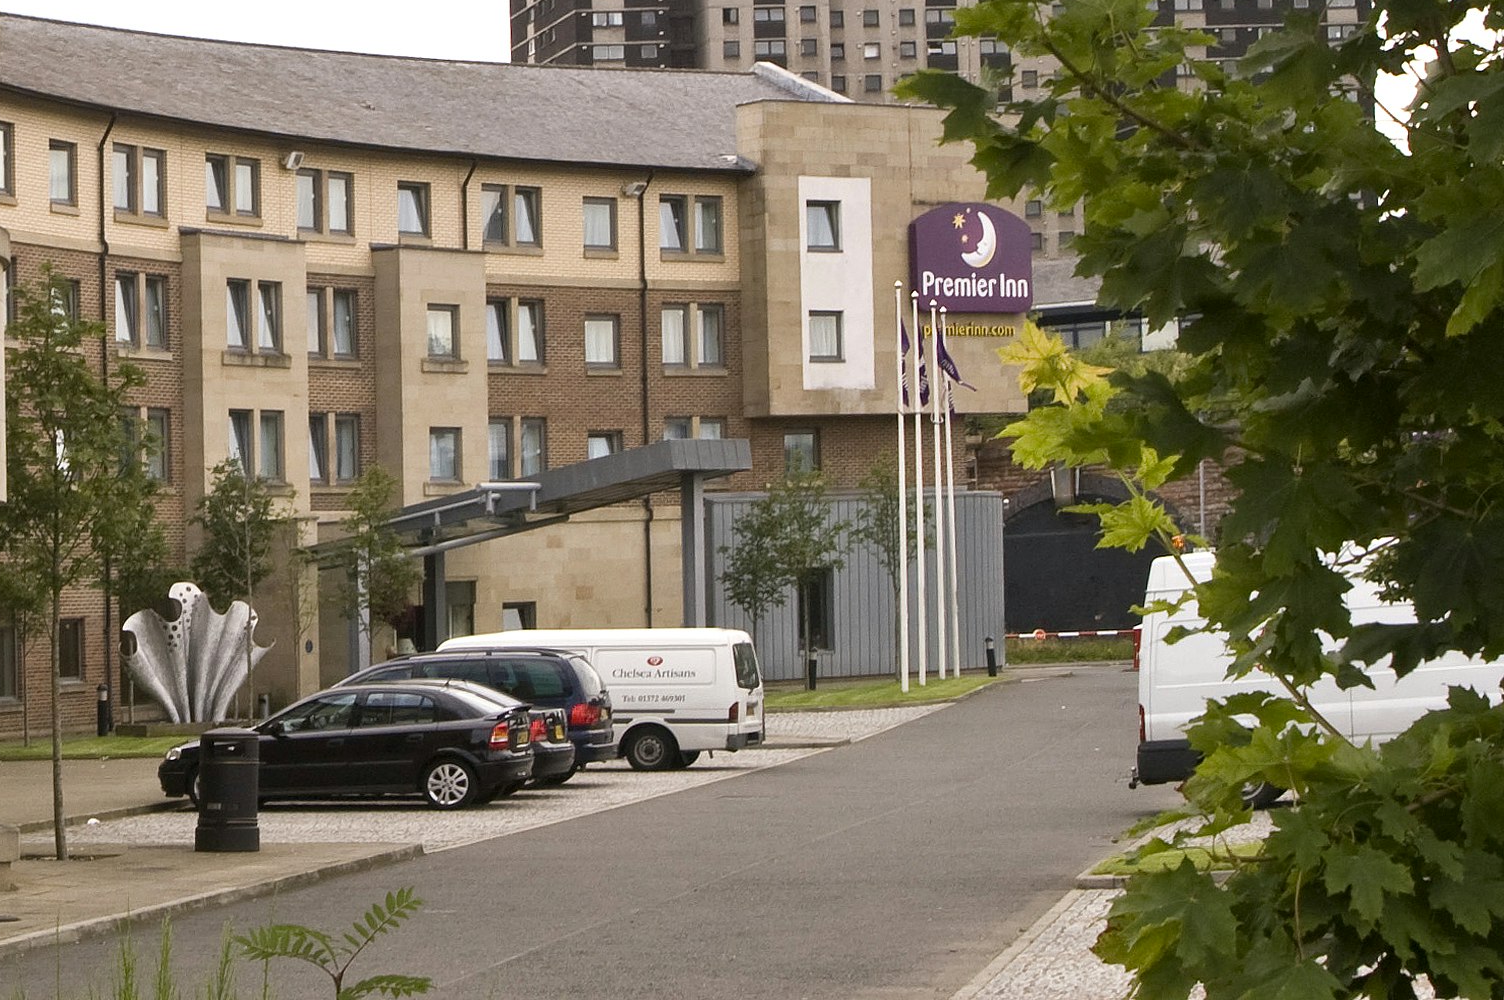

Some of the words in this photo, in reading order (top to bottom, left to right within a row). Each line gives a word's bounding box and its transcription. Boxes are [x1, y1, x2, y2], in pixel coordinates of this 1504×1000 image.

[922, 271, 997, 297] Premier
[999, 273, 1029, 298] Inn
[924, 321, 1016, 339] pmierinn.com
[612, 668, 652, 679] Chelsea
[654, 668, 696, 679] Artisans
